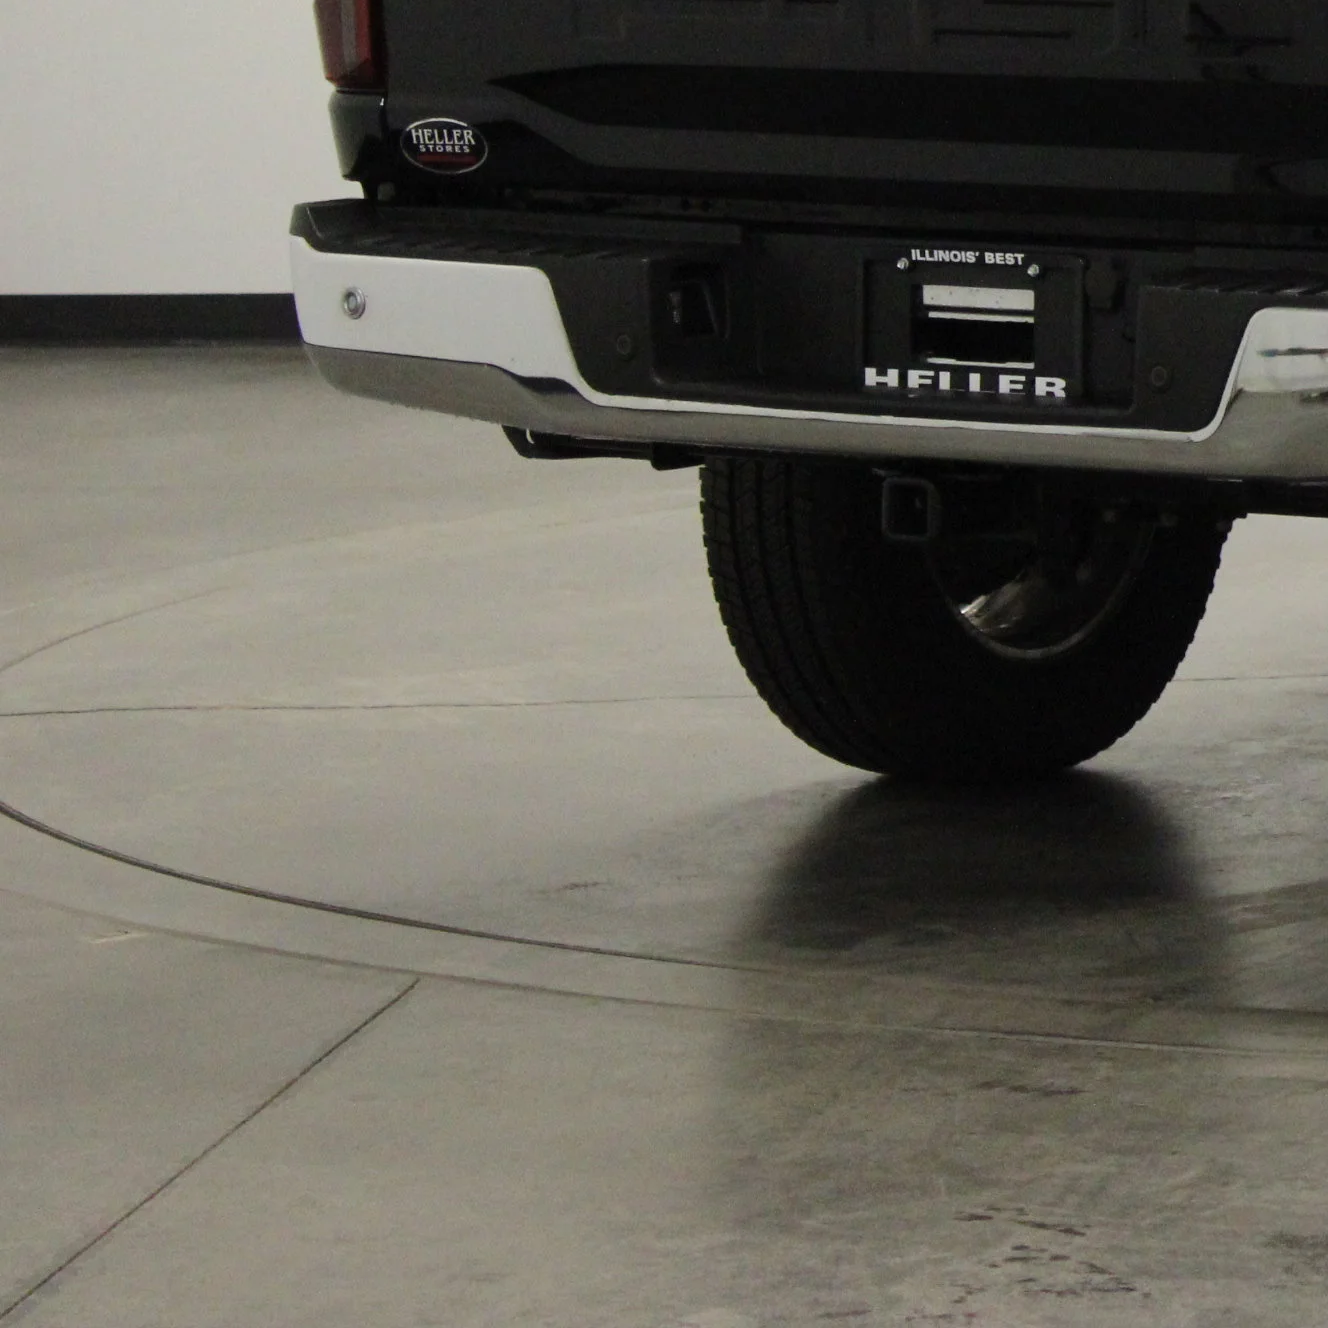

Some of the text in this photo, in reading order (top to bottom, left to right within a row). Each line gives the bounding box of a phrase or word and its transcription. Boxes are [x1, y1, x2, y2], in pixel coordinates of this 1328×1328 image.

[411, 128, 476, 145] HELLER
[419, 144, 470, 153] STORES
[985, 252, 1025, 266] BEST
